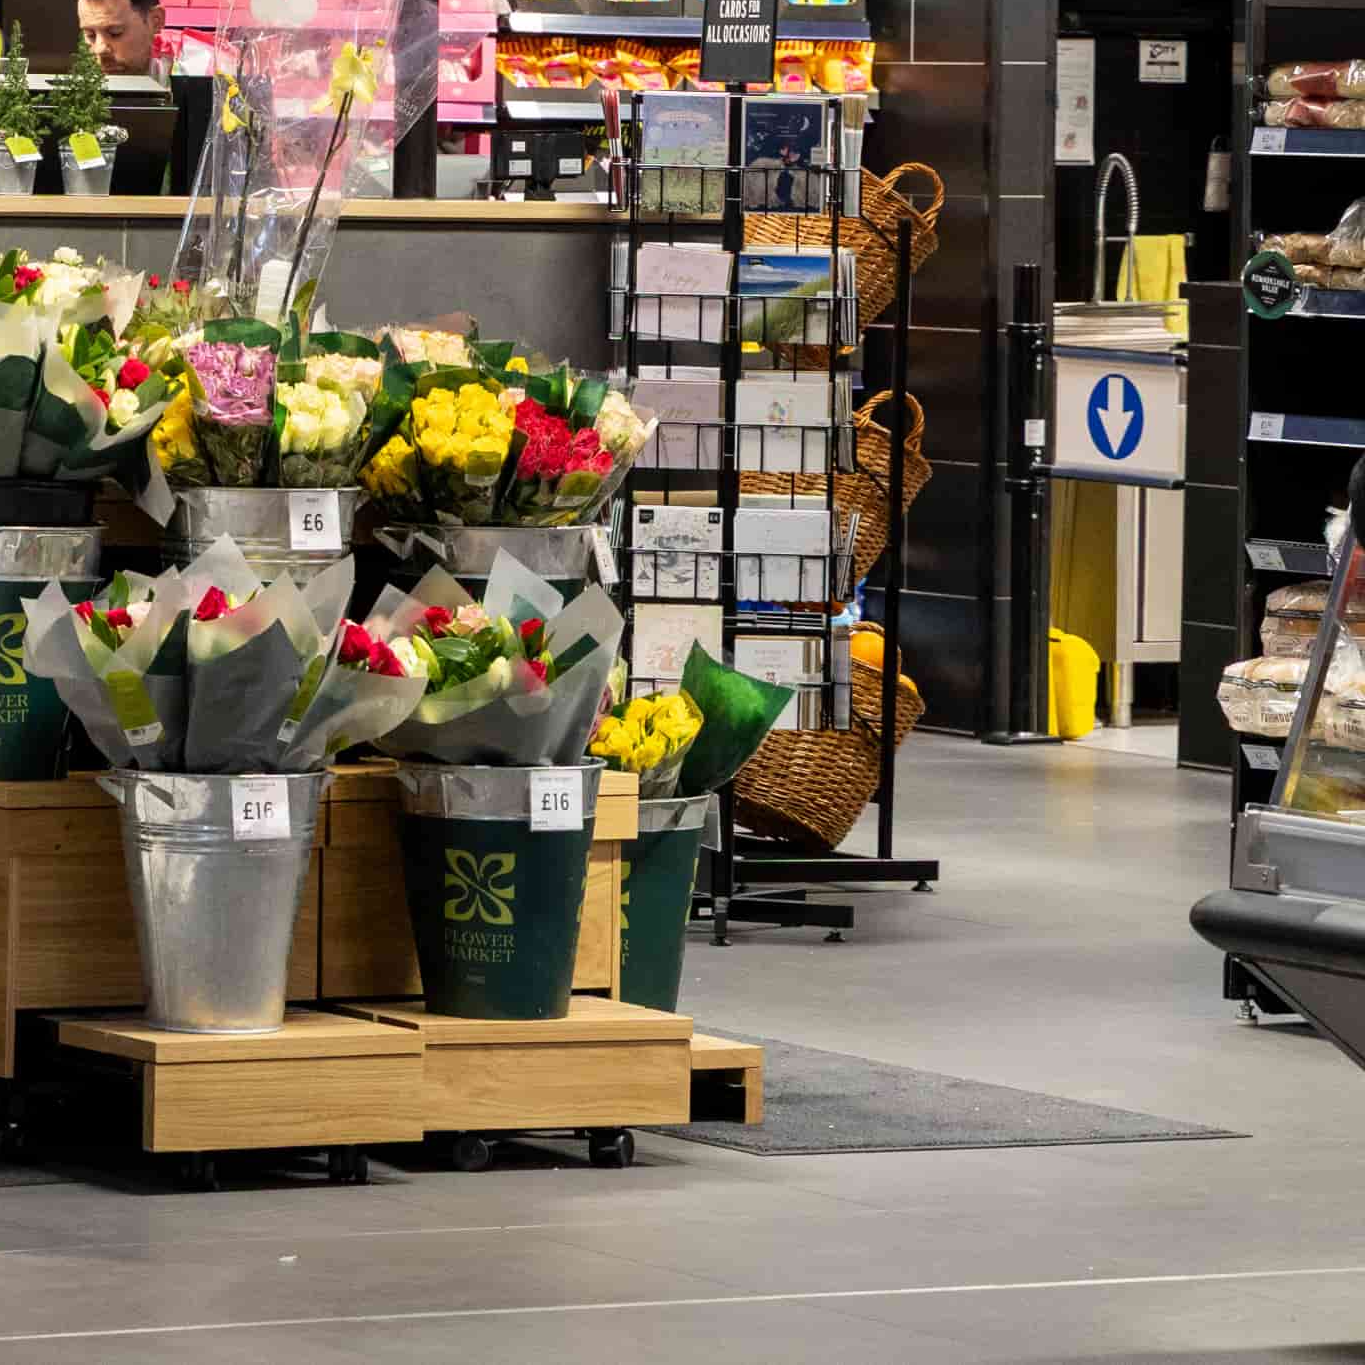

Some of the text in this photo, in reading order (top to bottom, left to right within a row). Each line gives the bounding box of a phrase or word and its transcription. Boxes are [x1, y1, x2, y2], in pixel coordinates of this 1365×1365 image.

[719, 0, 748, 19] CARDS
[706, 25, 771, 43] ALL OCCASIONS
[302, 513, 324, 531] £6
[242, 801, 275, 820] £16
[541, 792, 570, 811] £16
